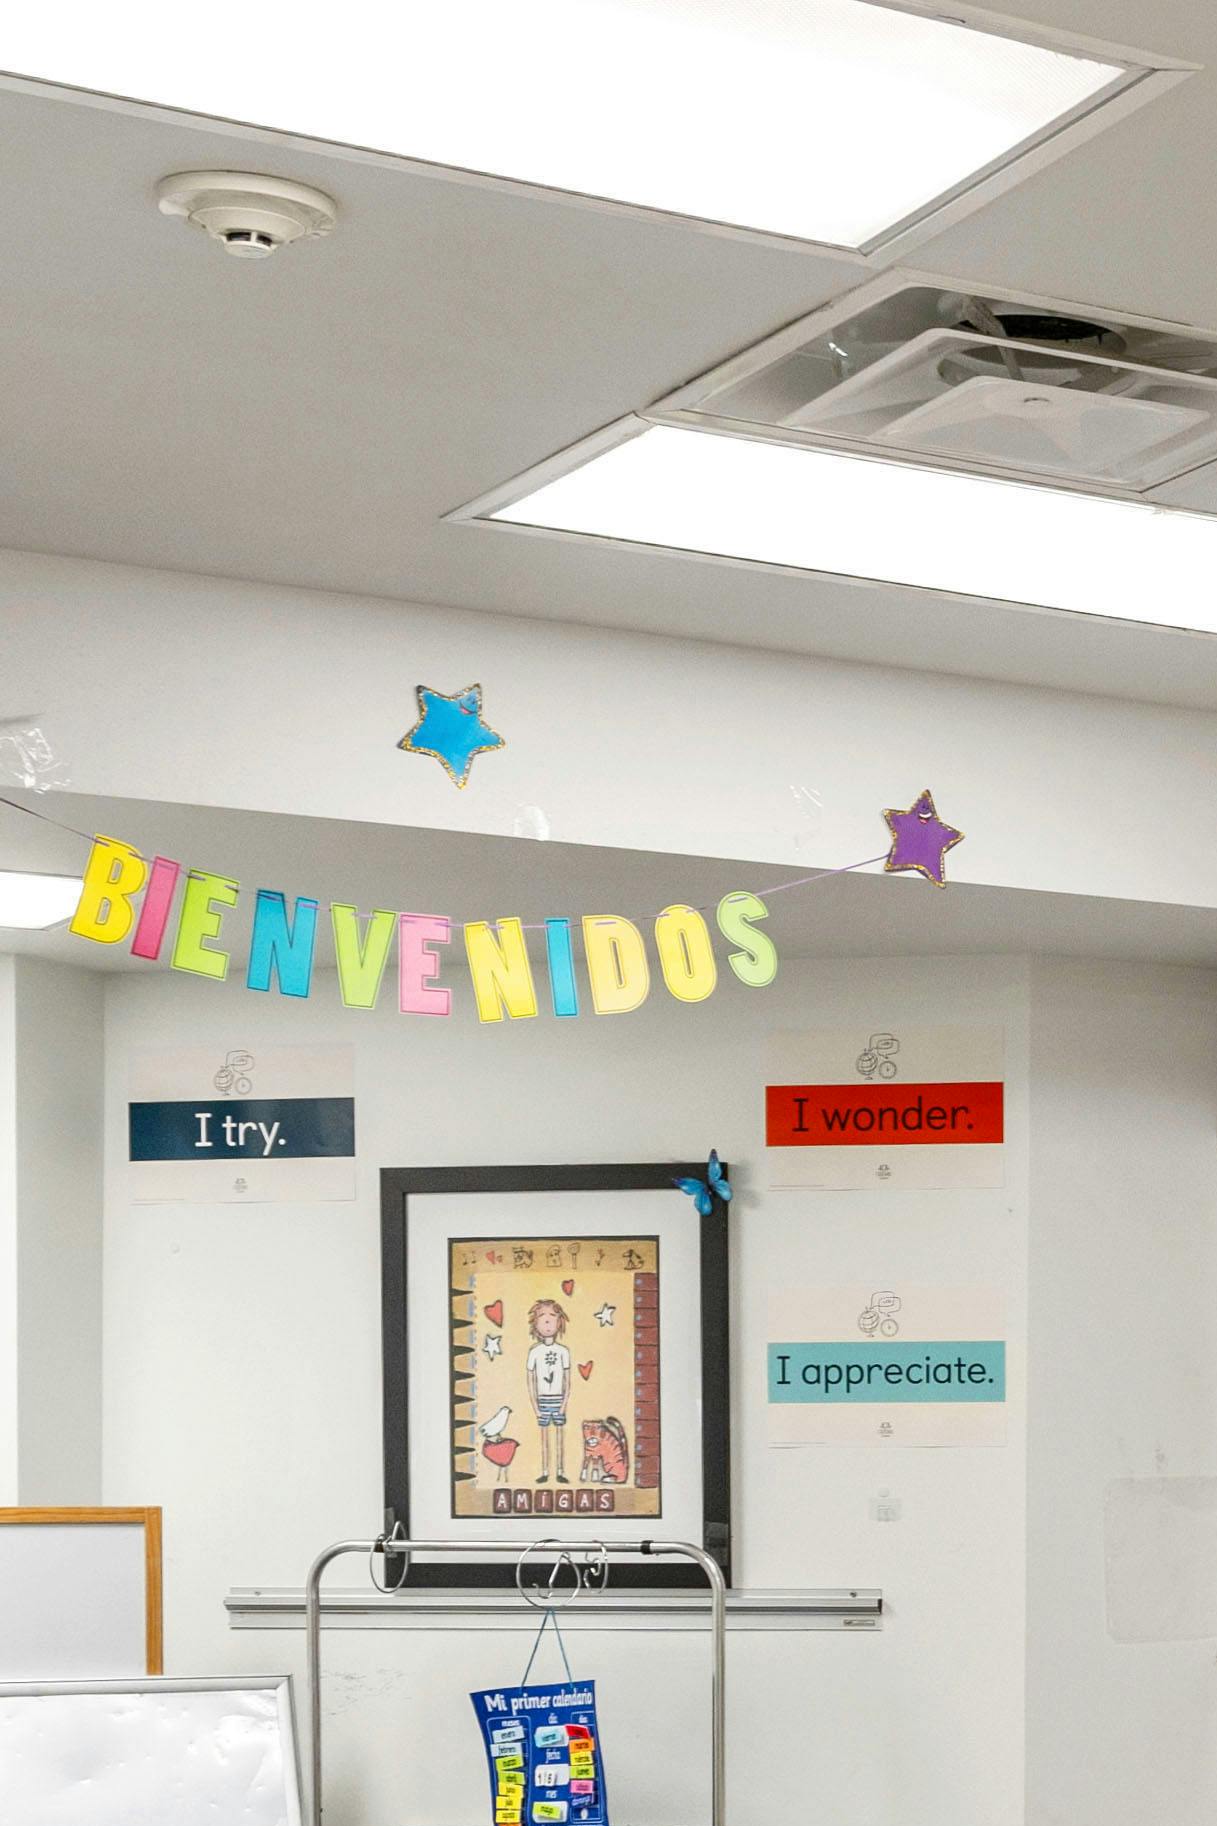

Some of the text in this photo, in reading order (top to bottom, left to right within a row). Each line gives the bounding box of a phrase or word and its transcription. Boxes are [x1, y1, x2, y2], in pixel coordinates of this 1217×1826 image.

[69, 833, 778, 1024] BIENVENIDOS
[792, 1095, 974, 1132] I wonder.
[194, 1112, 287, 1156] I try.
[776, 1356, 994, 1394] I appreciate.
[484, 1688, 593, 1716] Mi primer calendario
